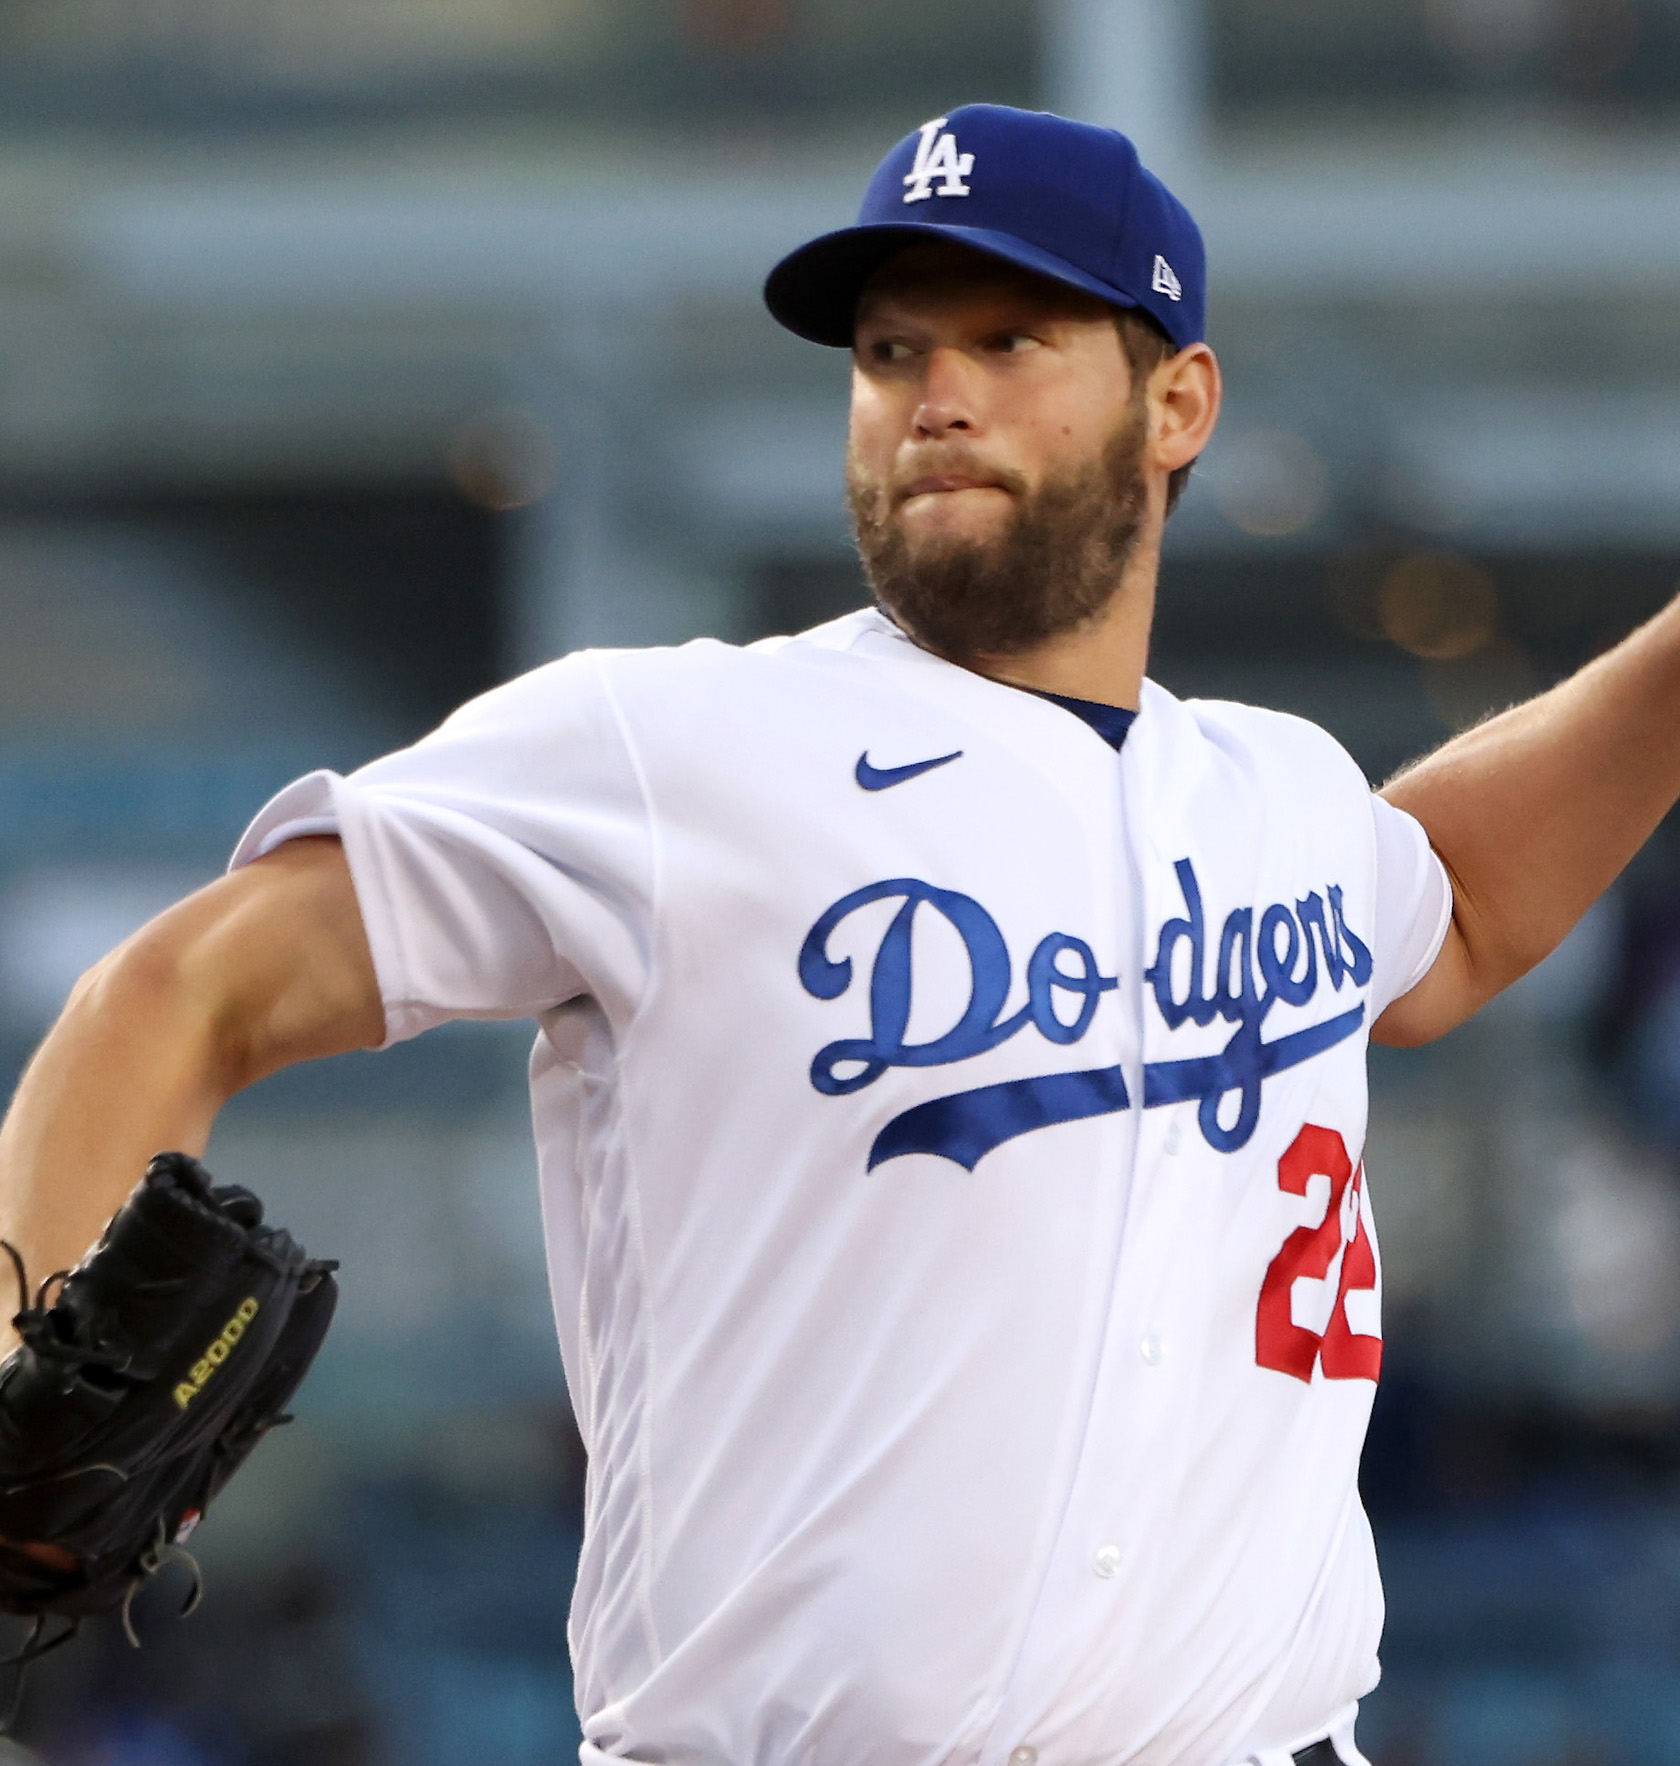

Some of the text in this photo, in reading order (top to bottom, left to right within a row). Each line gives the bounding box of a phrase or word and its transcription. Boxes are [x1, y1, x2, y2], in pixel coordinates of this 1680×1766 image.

[903, 117, 976, 203] LA
[798, 856, 1373, 1153] Dodgers
[1256, 1122, 1383, 1385] 22
[173, 1297, 260, 1409] A2000
